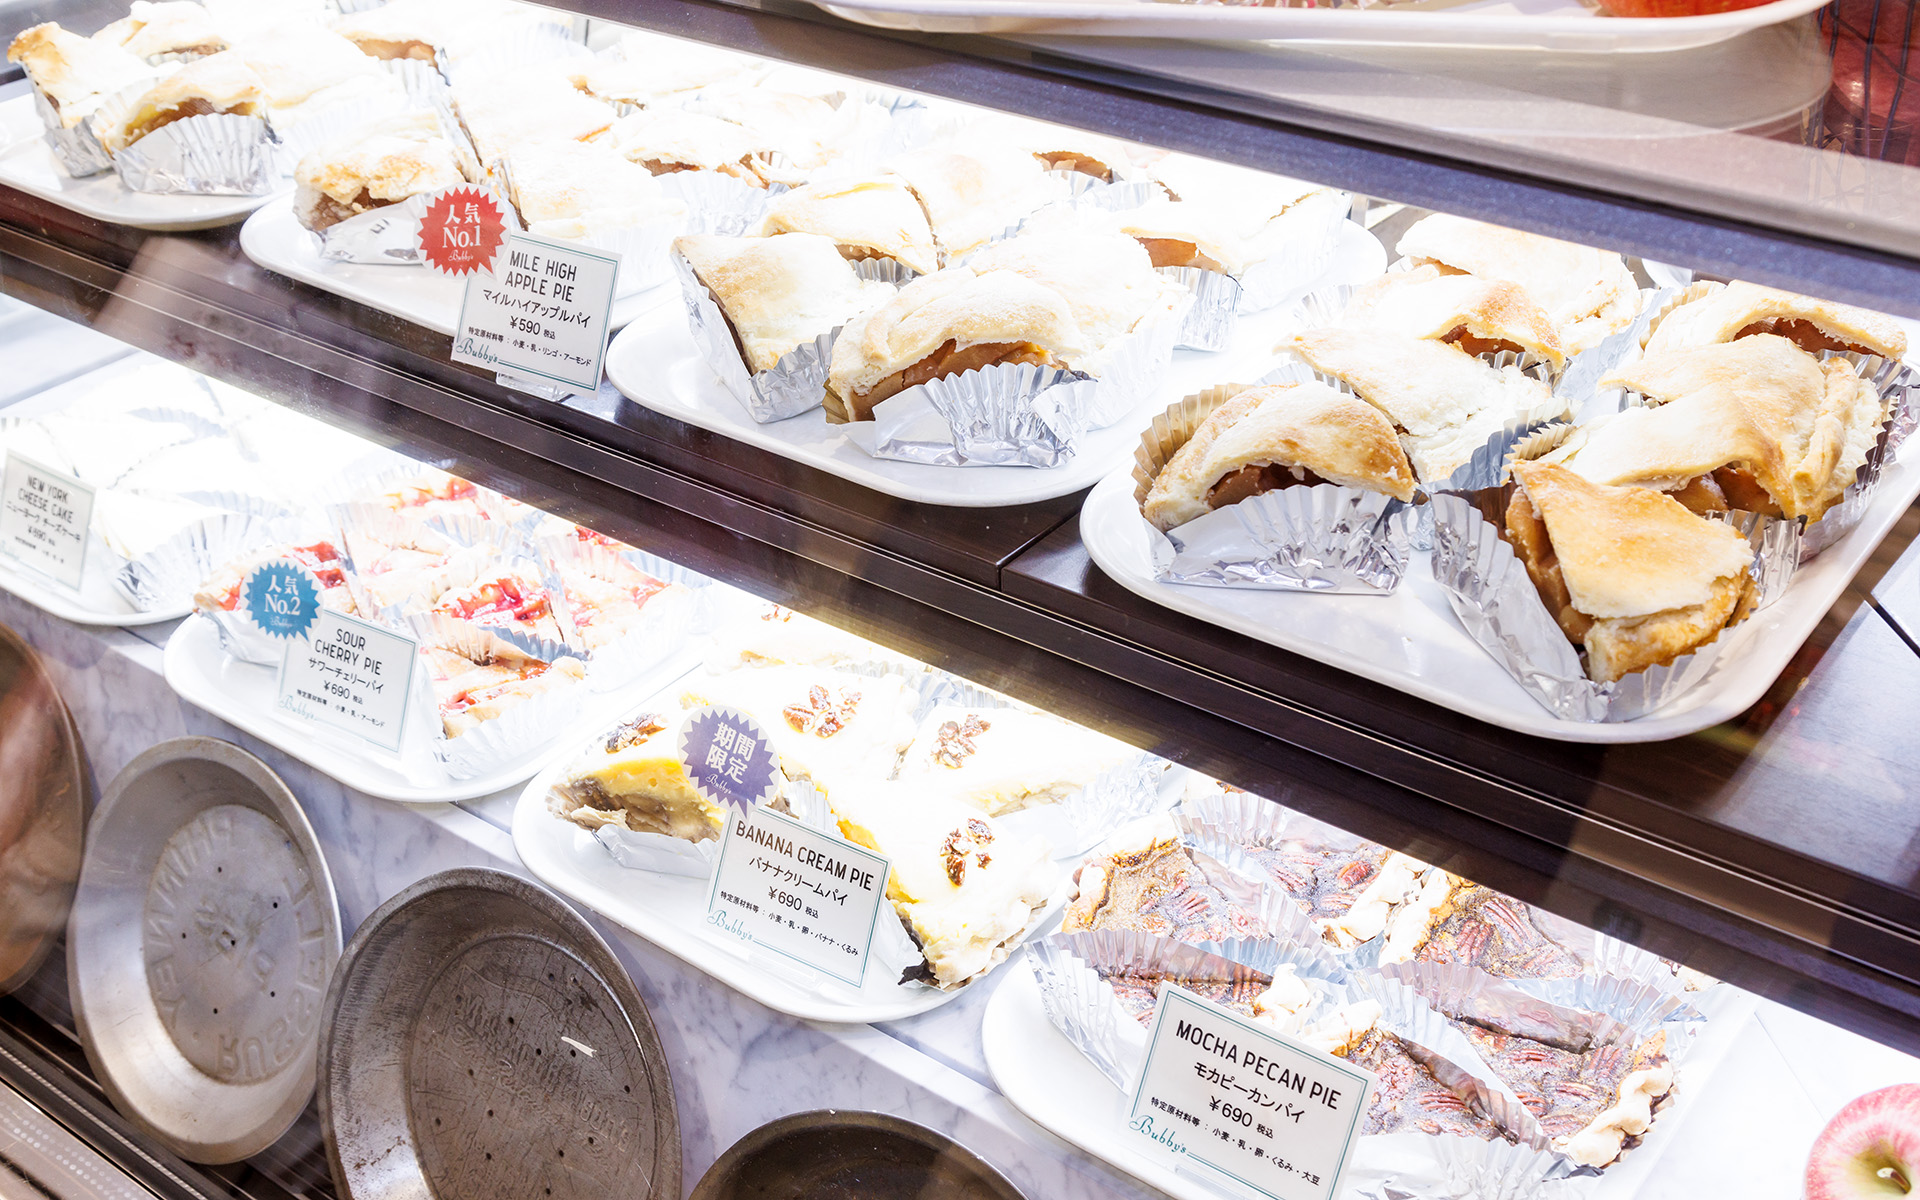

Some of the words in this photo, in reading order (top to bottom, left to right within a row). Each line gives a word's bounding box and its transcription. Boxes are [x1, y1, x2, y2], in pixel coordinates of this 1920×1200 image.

[445, 202, 481, 225] 人気
[442, 225, 481, 249] No.1
[509, 250, 541, 273] MILE
[545, 259, 577, 282] HIGH
[505, 271, 548, 296] APPLE
[553, 282, 575, 303] PIE
[483, 289, 591, 329] マイルハイアップルパイ
[509, 315, 541, 336] ¥590
[455, 337, 498, 364] Bubby's
[18, 488, 48, 512] CHEESE
[51, 503, 74, 524] CAKE
[26, 475, 45, 493] NEW
[47, 484, 69, 504] YORK
[267, 574, 299, 596] 人気
[264, 593, 301, 616] No.2
[335, 628, 366, 651] SOUR
[315, 639, 360, 667] CHERRY
[364, 657, 382, 676] PIE
[308, 657, 384, 695] サワーチェリーパイ
[324, 680, 350, 699] ¥690
[714, 721, 757, 762] 期間
[704, 744, 748, 785] 限定
[705, 774, 732, 795] Bubby's
[735, 820, 793, 858] BANANA
[797, 846, 847, 881] CREAM
[849, 868, 874, 892] PIE
[749, 856, 849, 906] バナナクリームパイ
[768, 885, 803, 911] ¥690
[805, 906, 819, 919] 税込
[706, 909, 753, 942] Bubby's
[1176, 1019, 1238, 1064] MOCHA
[1242, 1050, 1308, 1094] PECAN
[1309, 1080, 1342, 1110] PIE
[1194, 1062, 1305, 1124] モカピーカンパイ
[1209, 1095, 1253, 1128] ¥690
[1256, 1123, 1275, 1139] 税込
[1128, 1114, 1187, 1155] Bubby's
